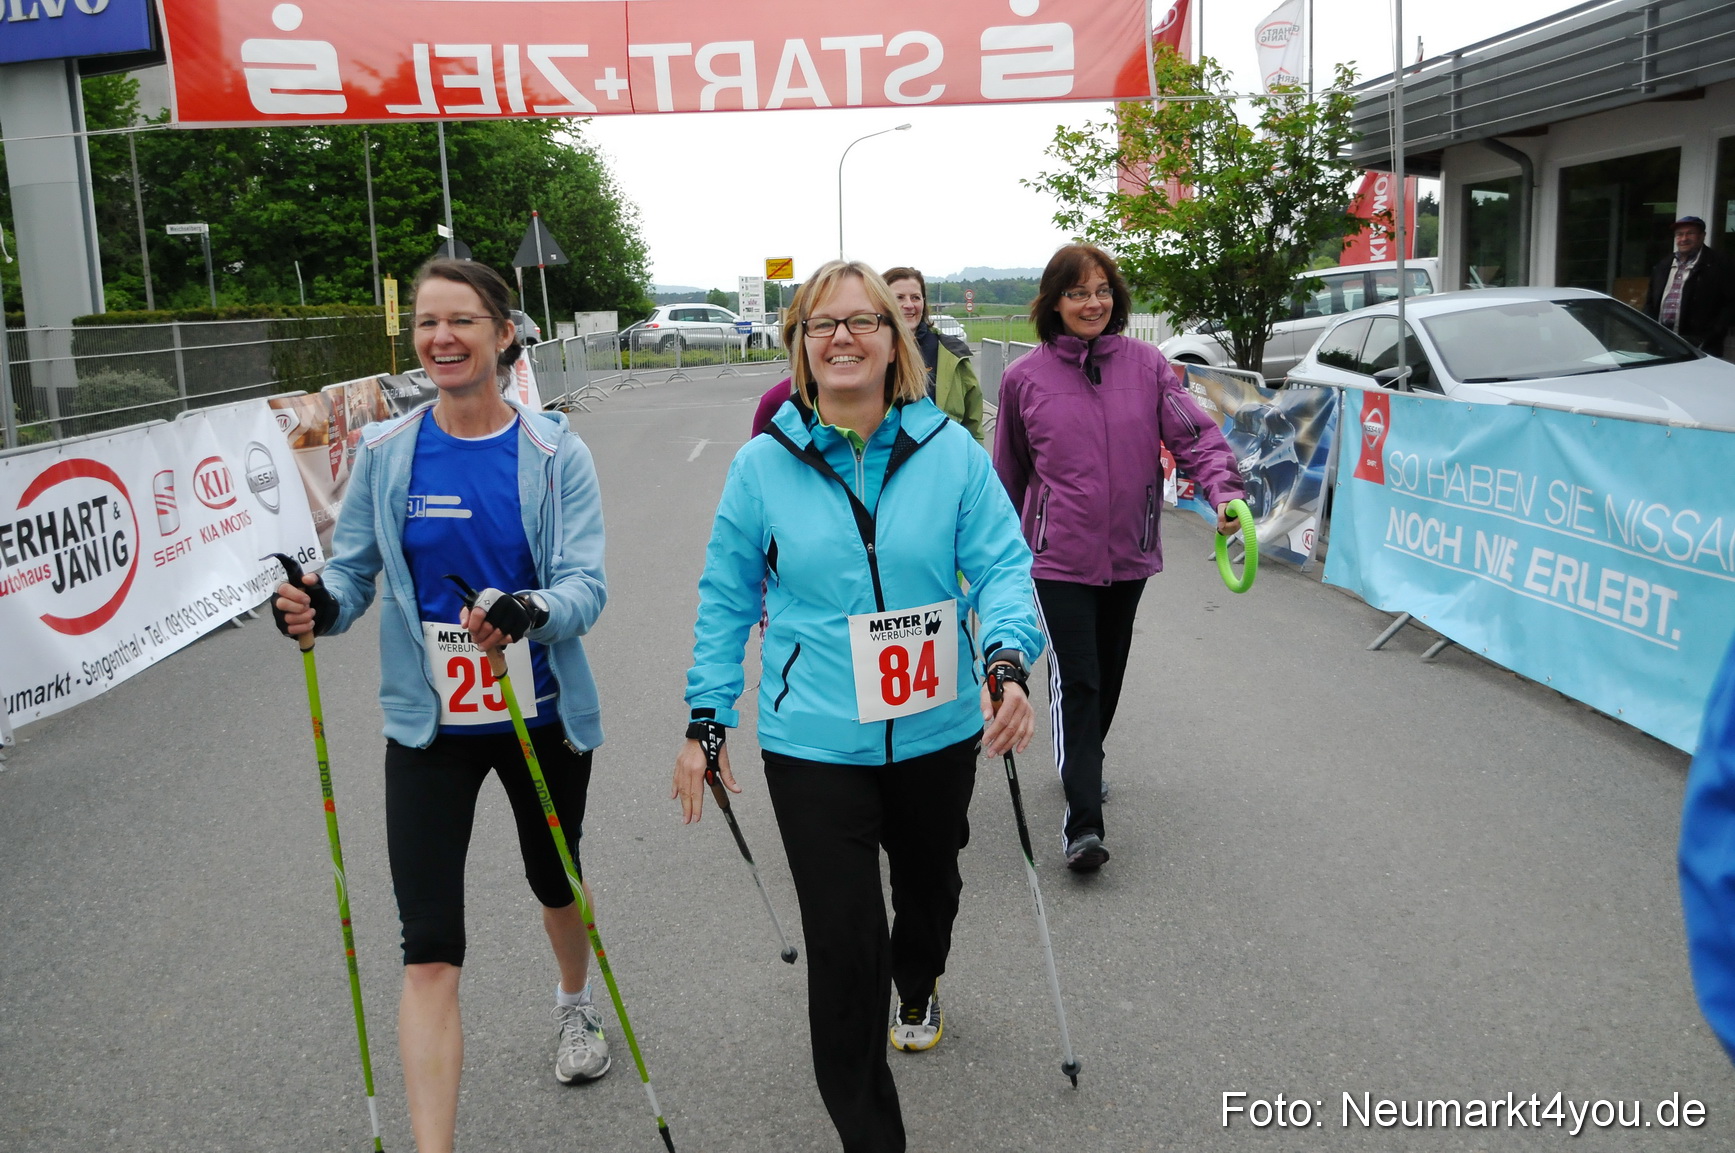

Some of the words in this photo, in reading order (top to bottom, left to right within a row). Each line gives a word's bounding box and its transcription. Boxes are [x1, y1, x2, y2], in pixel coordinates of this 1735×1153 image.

[1389, 450, 1420, 491] SO
[1427, 458, 1537, 517] HABEN
[1545, 479, 1595, 535] SIE
[0, 495, 108, 570] ERHART
[153, 536, 192, 567] SEAT
[199, 524, 221, 544] KIA
[0, 563, 51, 597] utohaus
[51, 530, 129, 594] JÄNIG
[1385, 506, 1463, 564] NOCH
[1474, 530, 1518, 583] NIE
[1523, 546, 1681, 641] ERLEBT.
[869, 614, 922, 633] MEYER
[870, 627, 923, 641] WERBUNG
[4, 672, 71, 715] umarkt
[81, 633, 143, 686] Sengenthal
[144, 621, 170, 647] Tel.
[165, 596, 219, 636] 09181/26
[878, 639, 940, 706] 84
[446, 655, 509, 714] 25
[318, 760, 333, 798] pole
[533, 779, 554, 814] pole
